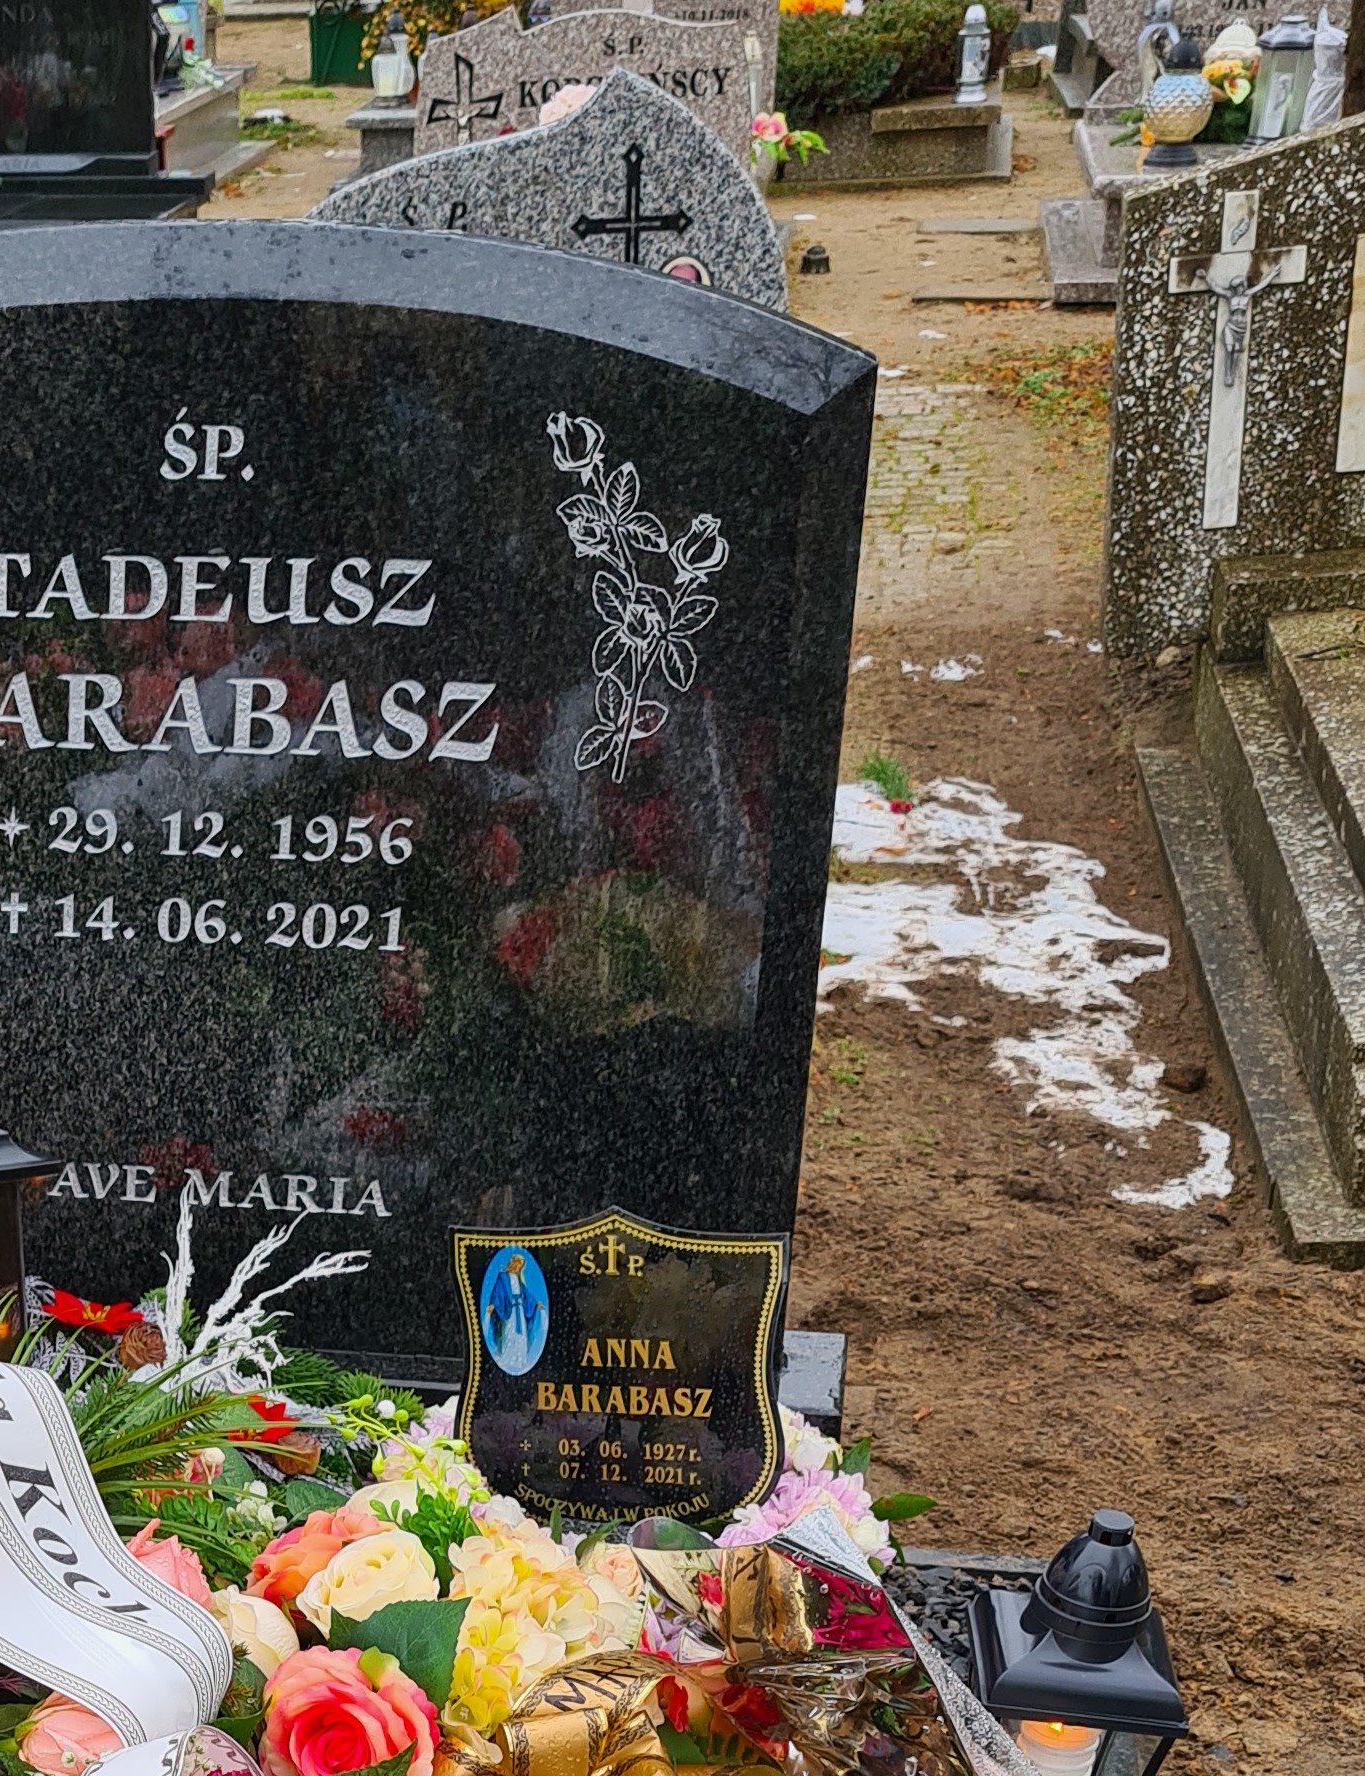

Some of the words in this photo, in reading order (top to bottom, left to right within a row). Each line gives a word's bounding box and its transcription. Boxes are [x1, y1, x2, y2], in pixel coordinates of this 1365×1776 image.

[158, 406, 256, 482] ŚP.
[47, 807, 134, 856] 29.
[159, 810, 245, 860] 12.
[270, 814, 414, 867] 1956
[52, 895, 135, 942] 14.
[156, 897, 244, 946] 06.
[266, 902, 407, 953] 2021
[46, 1161, 157, 1203] AVE
[184, 1168, 393, 1217] MARIA
[580, 1337, 677, 1371] ANNA
[536, 1381, 714, 1419] BARABASZ
[558, 1438, 586, 1457] 03.
[599, 1440, 628, 1459] 06.
[558, 1461, 586, 1480] 07.
[599, 1463, 628, 1482] 12.
